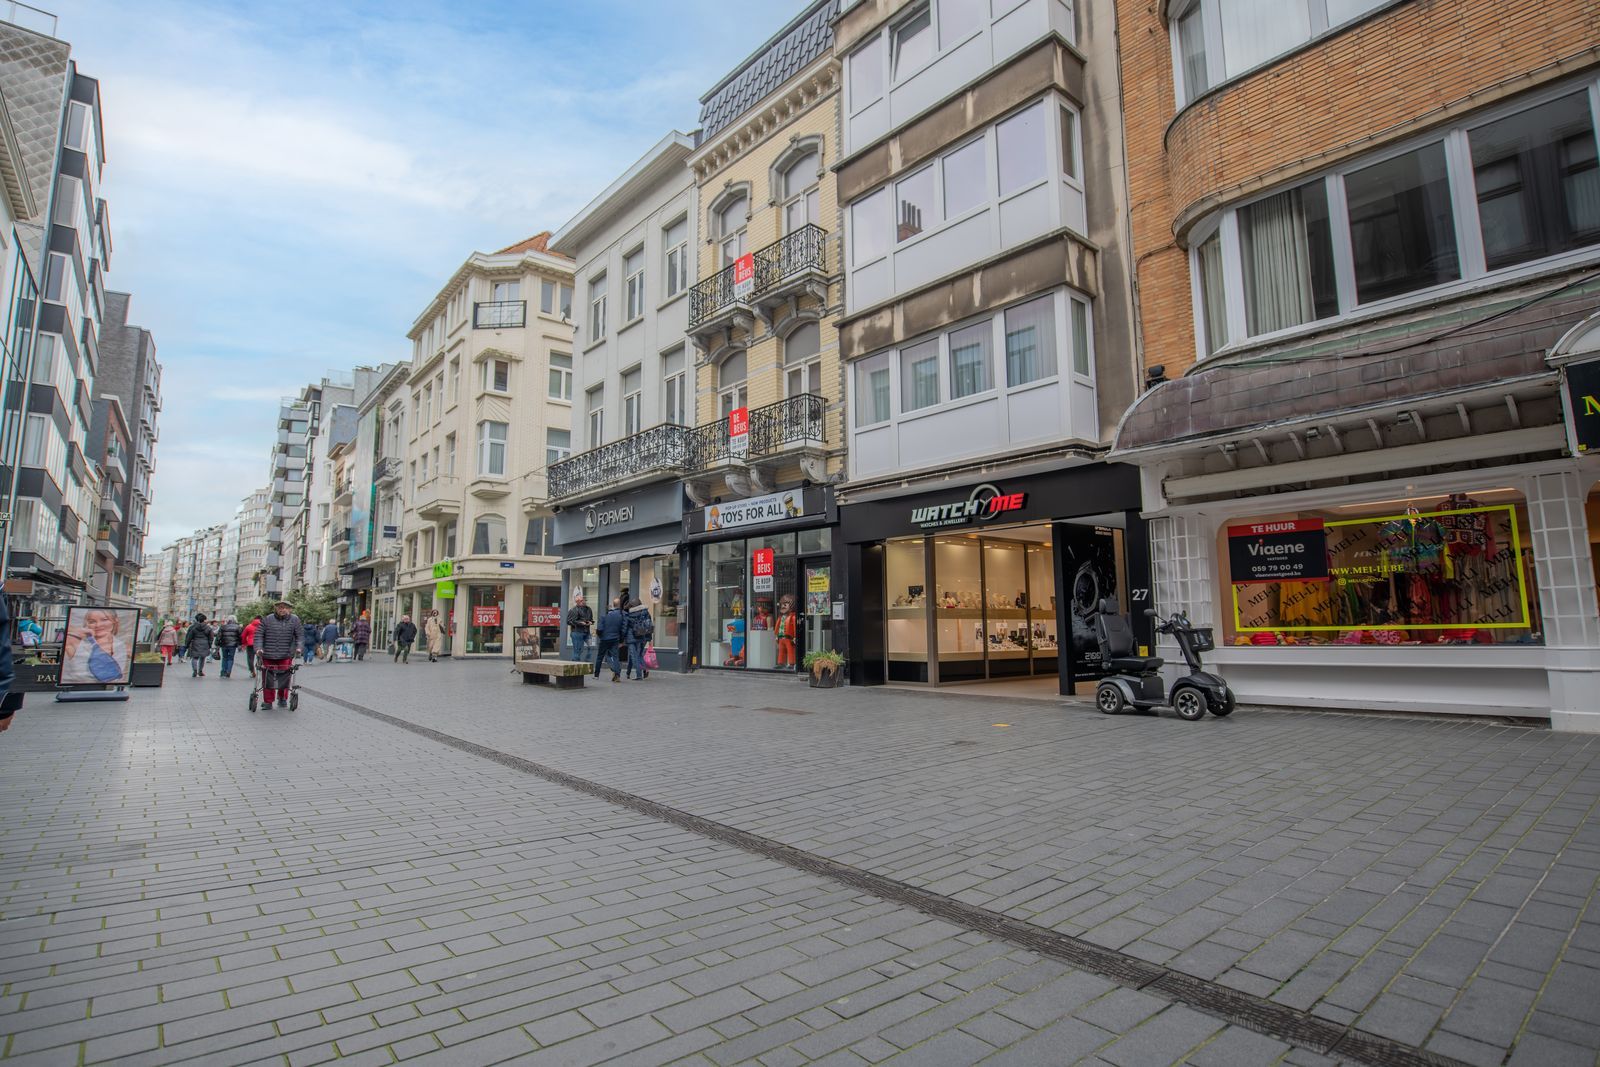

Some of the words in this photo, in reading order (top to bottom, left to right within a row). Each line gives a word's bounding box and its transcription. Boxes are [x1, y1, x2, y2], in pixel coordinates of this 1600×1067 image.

[738, 260, 745, 270] DE
[738, 267, 751, 280] BEUS
[733, 413, 740, 423] DE
[733, 421, 747, 434] BEUS
[721, 510, 743, 524] TOYS
[746, 507, 764, 521] FOR
[766, 503, 784, 517] ALL
[911, 499, 979, 523] WATCH
[989, 493, 1025, 513] ME
[597, 505, 634, 527] FORMEN
[1250, 525, 1264, 533] TE
[1265, 522, 1296, 533] HUUR
[1247, 538, 1305, 556] Viaene
[1328, 528, 1367, 557] MEI-LI
[757, 553, 764, 563] DE
[757, 563, 771, 574] BEUS
[1279, 563, 1291, 571] 00
[1132, 589, 1149, 601] 27
[477, 614, 496, 624] 30%
[532, 615, 551, 624] 30%
